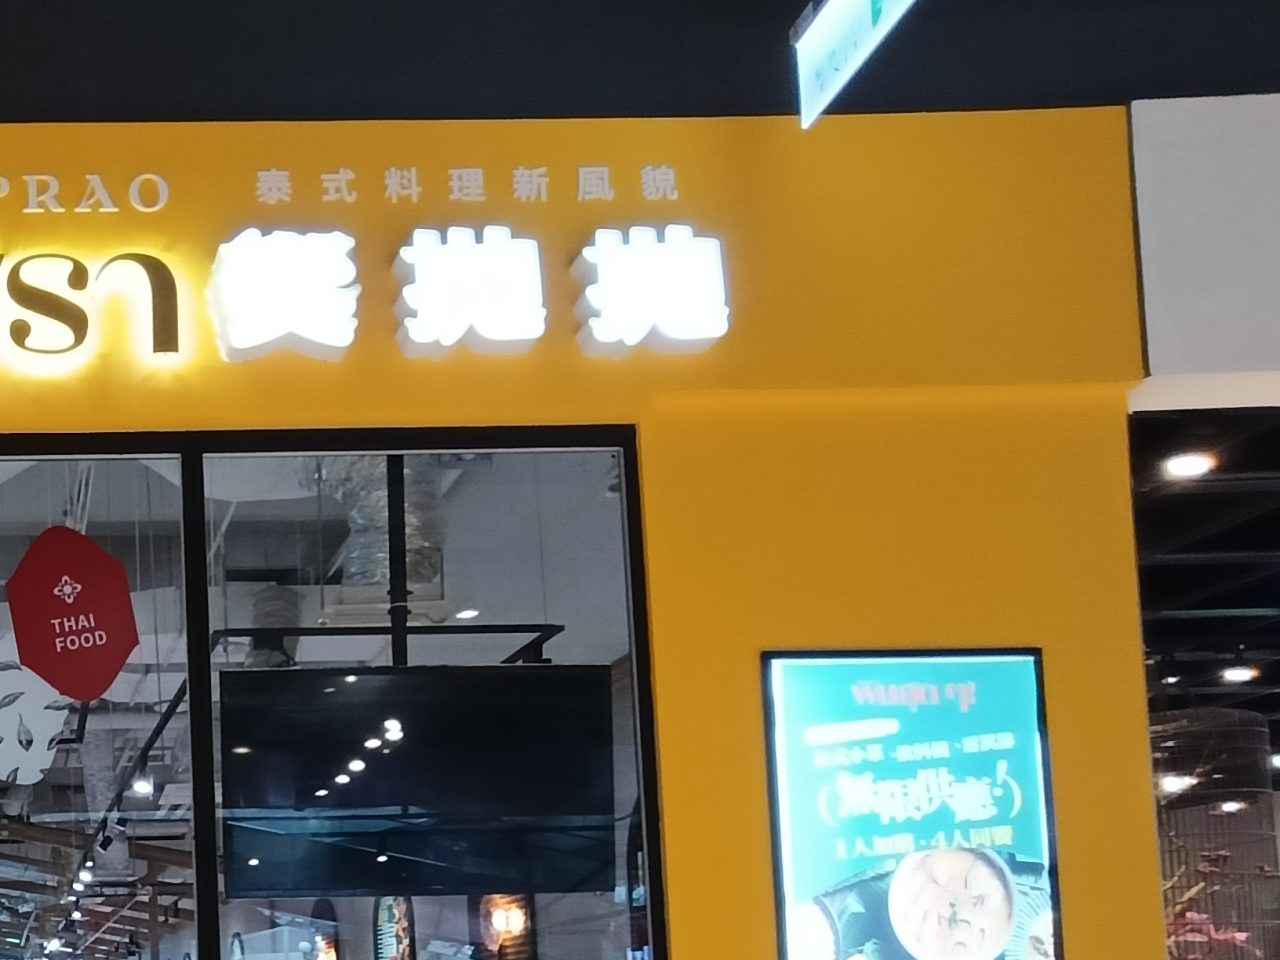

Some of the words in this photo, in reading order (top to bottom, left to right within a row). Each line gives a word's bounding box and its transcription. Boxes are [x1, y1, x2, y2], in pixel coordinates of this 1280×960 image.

[255, 165, 679, 205] 泰式料理新風貌
[51, 613, 96, 634] THAI
[55, 630, 107, 652] FOOD
